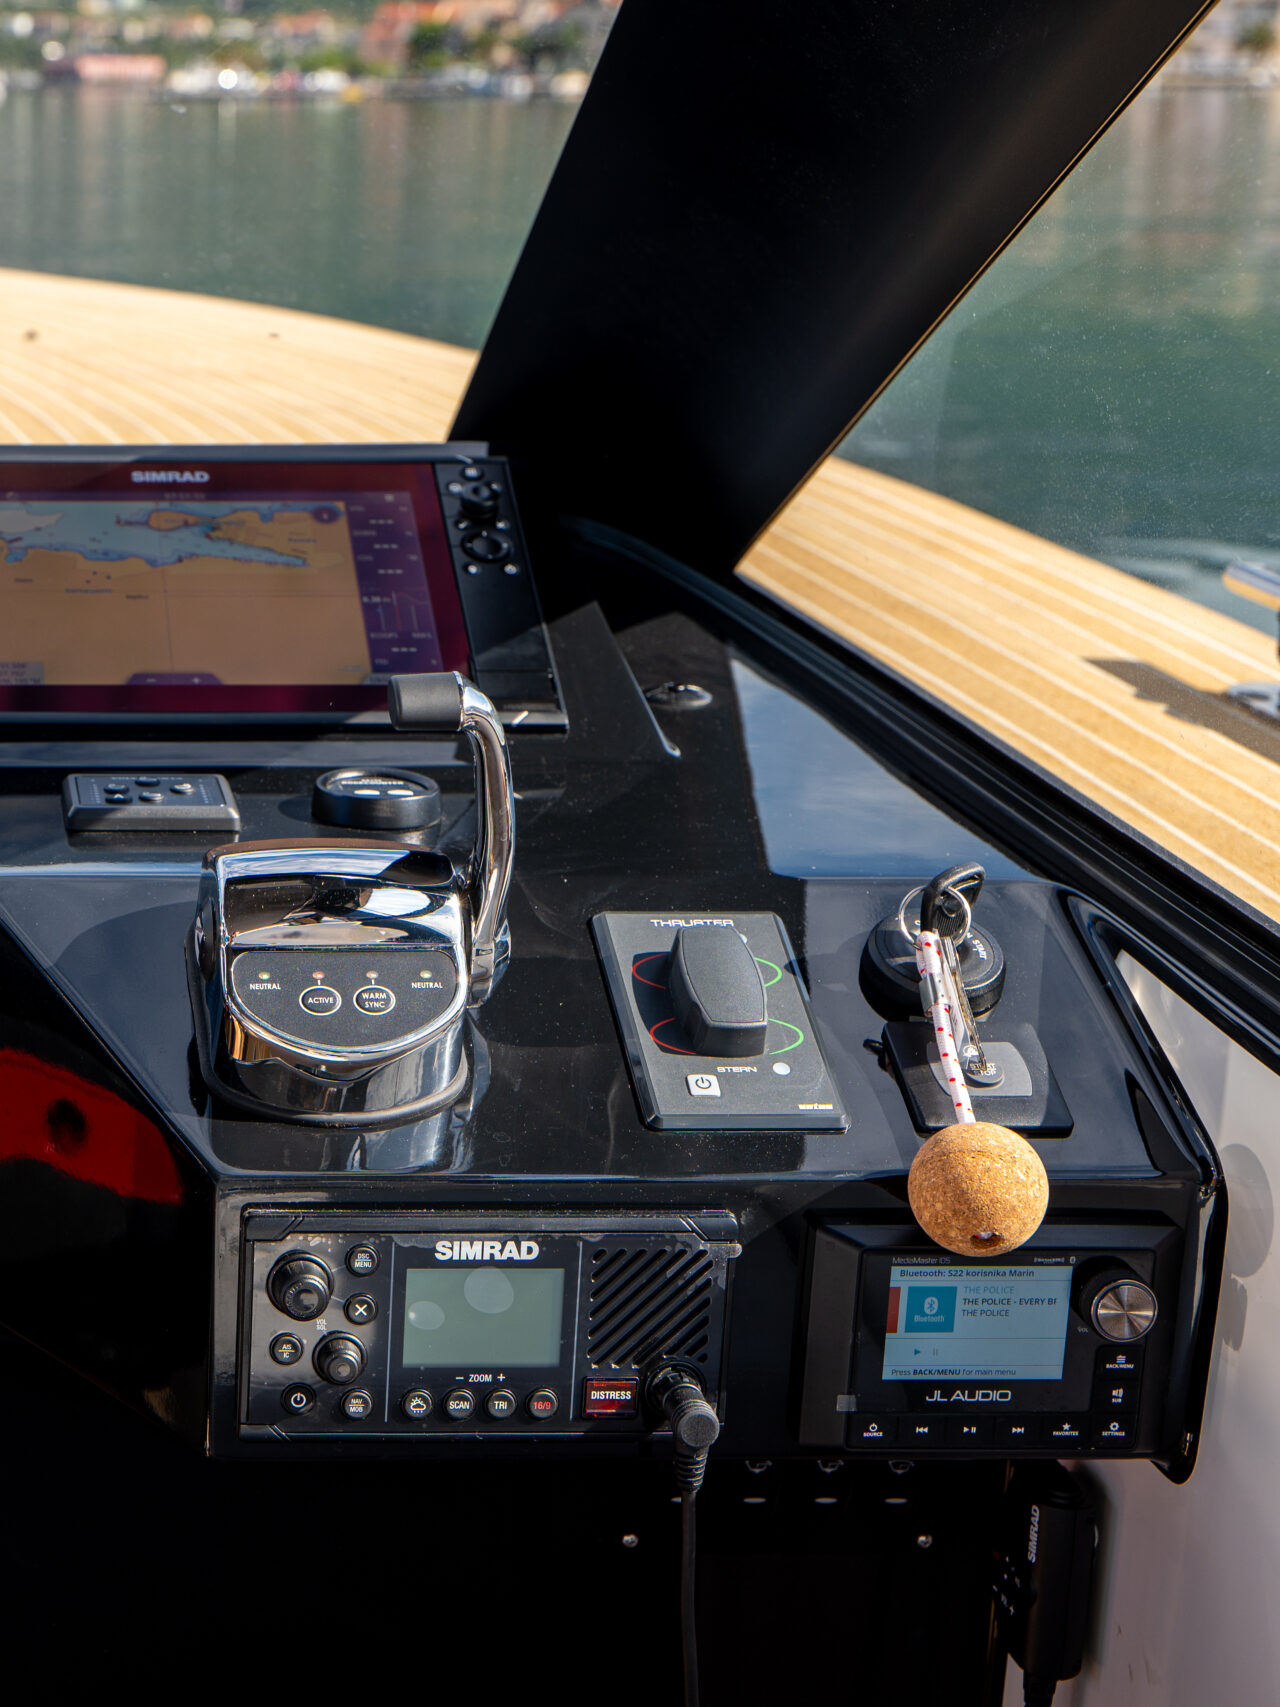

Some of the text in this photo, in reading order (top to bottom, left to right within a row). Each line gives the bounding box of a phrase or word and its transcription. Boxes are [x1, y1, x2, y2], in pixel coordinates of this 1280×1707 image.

[131, 470, 210, 484] SIMRAD
[650, 919, 735, 928] THRUSTER
[434, 1240, 540, 1261] SIMRAD
[900, 1269, 1035, 1277] Bluetooth: S22 korisnika Marin
[963, 1286, 1015, 1294] THE POLICE
[913, 1314, 945, 1322] Bluetooth
[912, 1368, 961, 1376] BACK/MENU
[962, 1368, 974, 1376] for
[974, 1368, 993, 1376] main
[468, 1373, 492, 1383] ZOOM
[590, 1390, 632, 1400] DISTRESS
[926, 1390, 1012, 1402] JL AUDIO
[449, 1400, 470, 1409] SCAN
[494, 1400, 508, 1409] TRI
[533, 1400, 551, 1410] 16/9
[1027, 1504, 1041, 1564] SIMRAD
